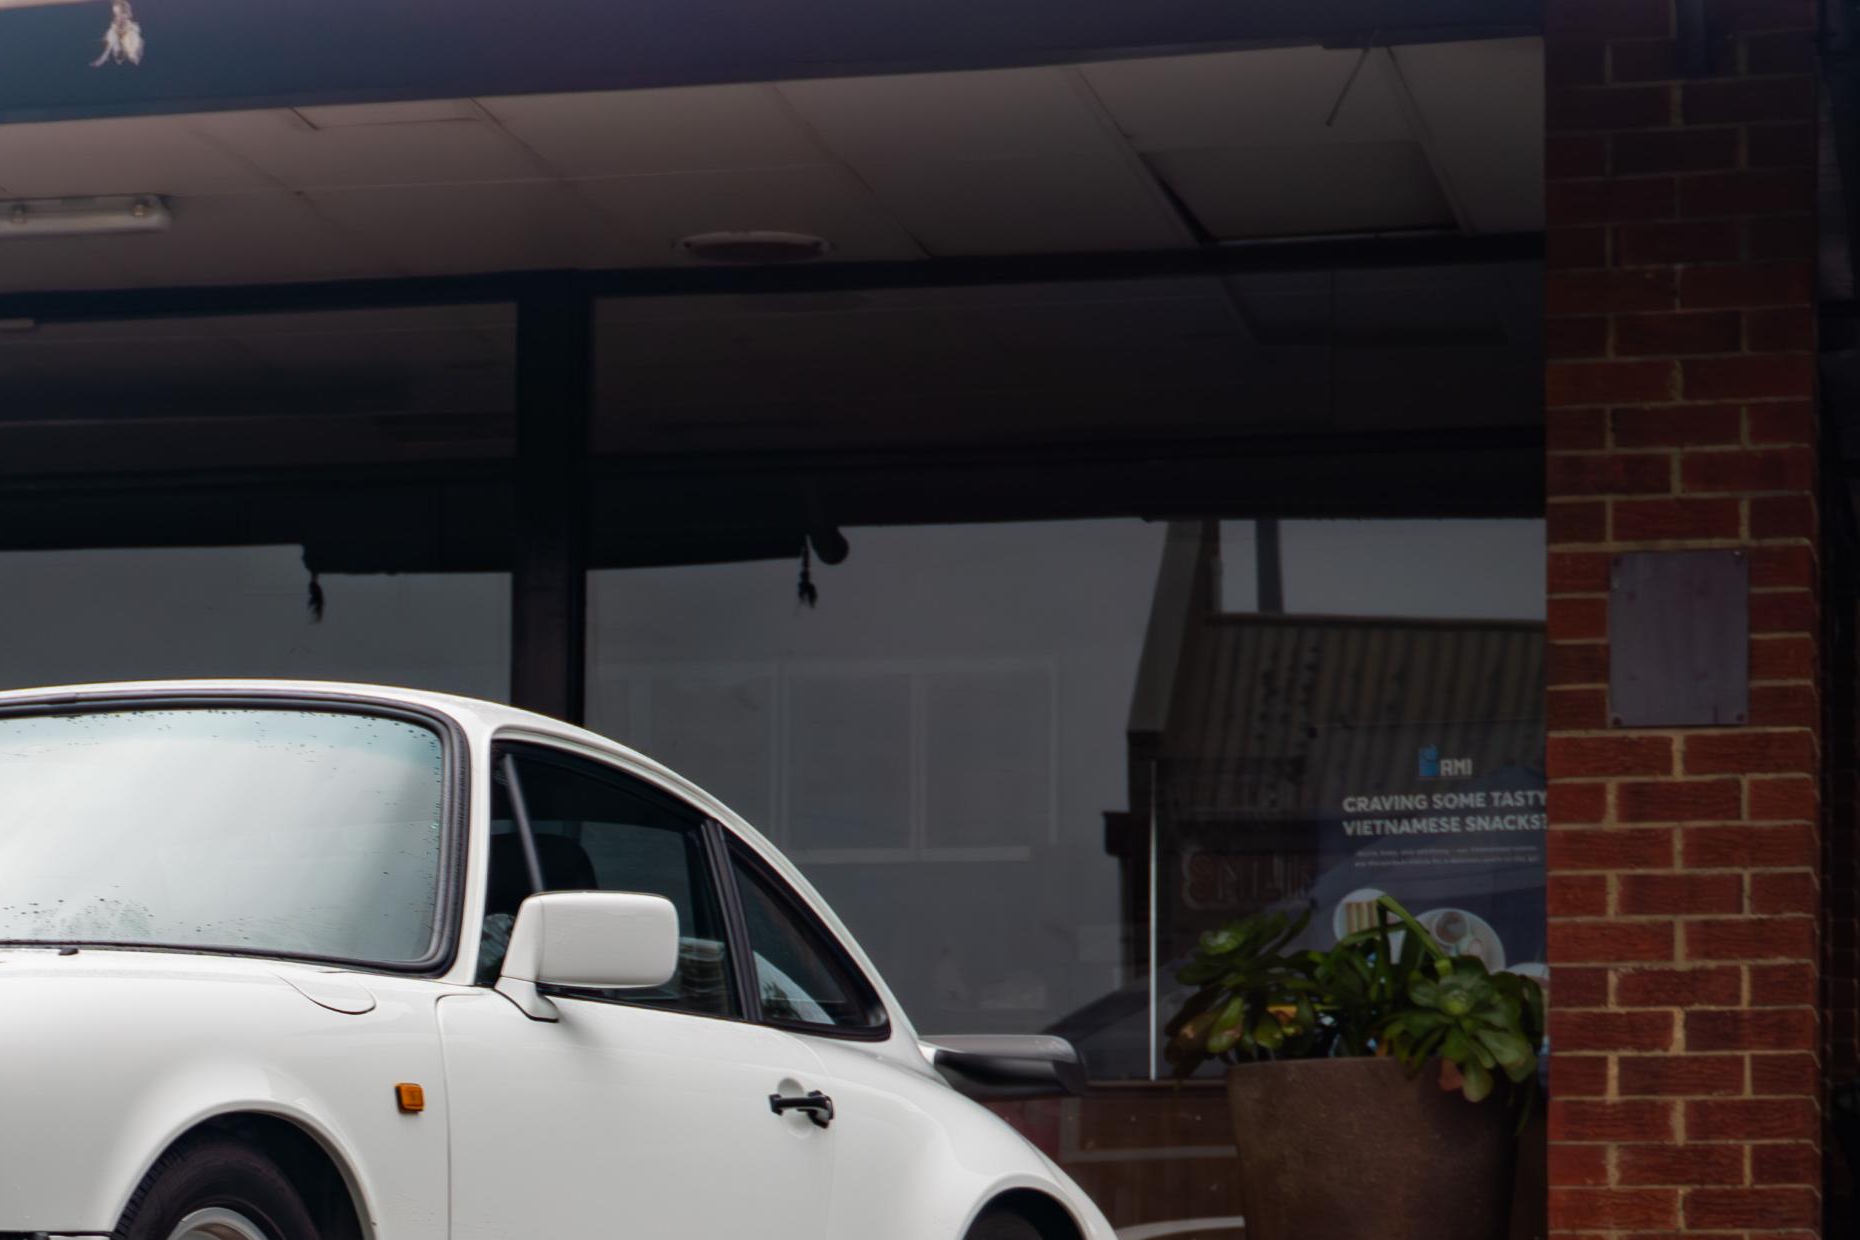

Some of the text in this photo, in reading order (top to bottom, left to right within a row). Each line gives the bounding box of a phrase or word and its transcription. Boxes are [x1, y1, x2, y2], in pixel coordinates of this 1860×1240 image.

[1342, 790, 1547, 813] CRAVING SOME TASTY
[1342, 815, 1461, 836] VIETNAMESE
